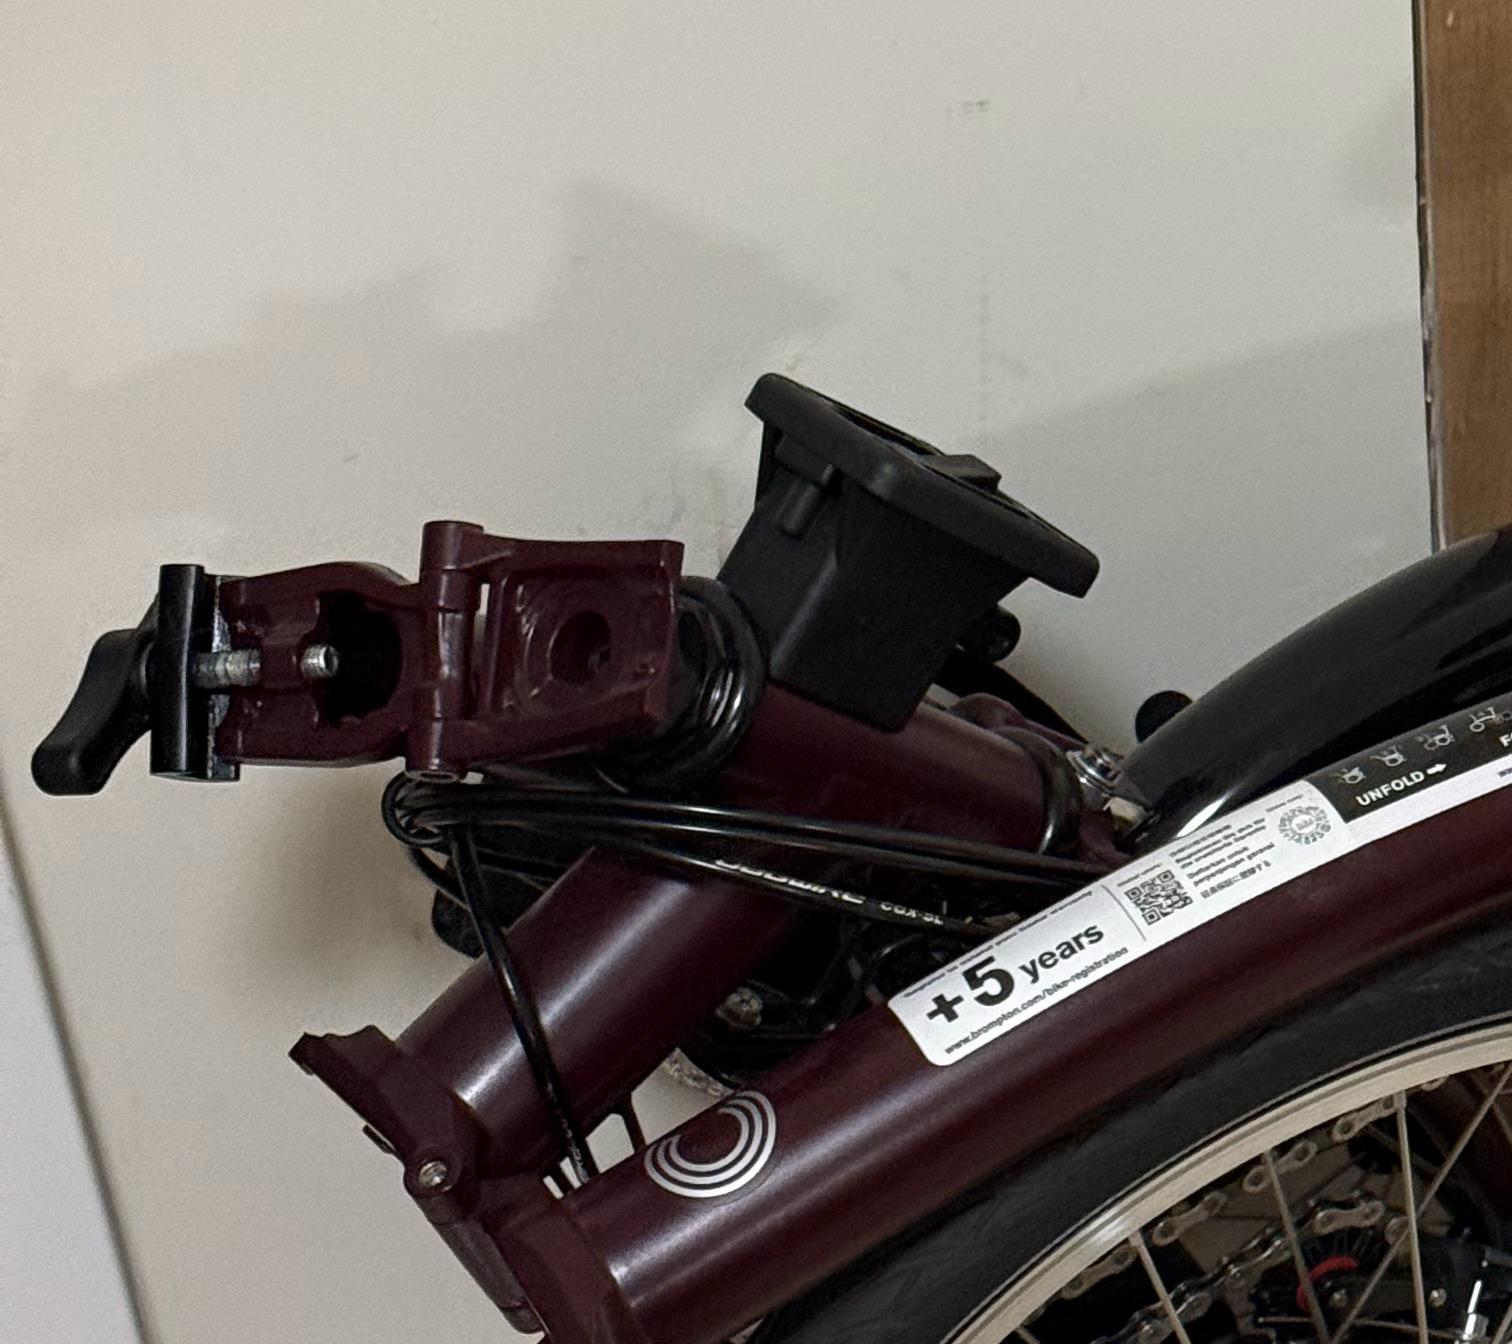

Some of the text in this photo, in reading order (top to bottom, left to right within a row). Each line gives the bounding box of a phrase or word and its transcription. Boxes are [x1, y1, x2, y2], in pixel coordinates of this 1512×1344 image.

[1355, 769, 1425, 807] UNFOLD
[926, 955, 1015, 1024] +5
[1018, 924, 1104, 985] years
[944, 947, 1129, 1055] www.brompton.com/bike-registration
